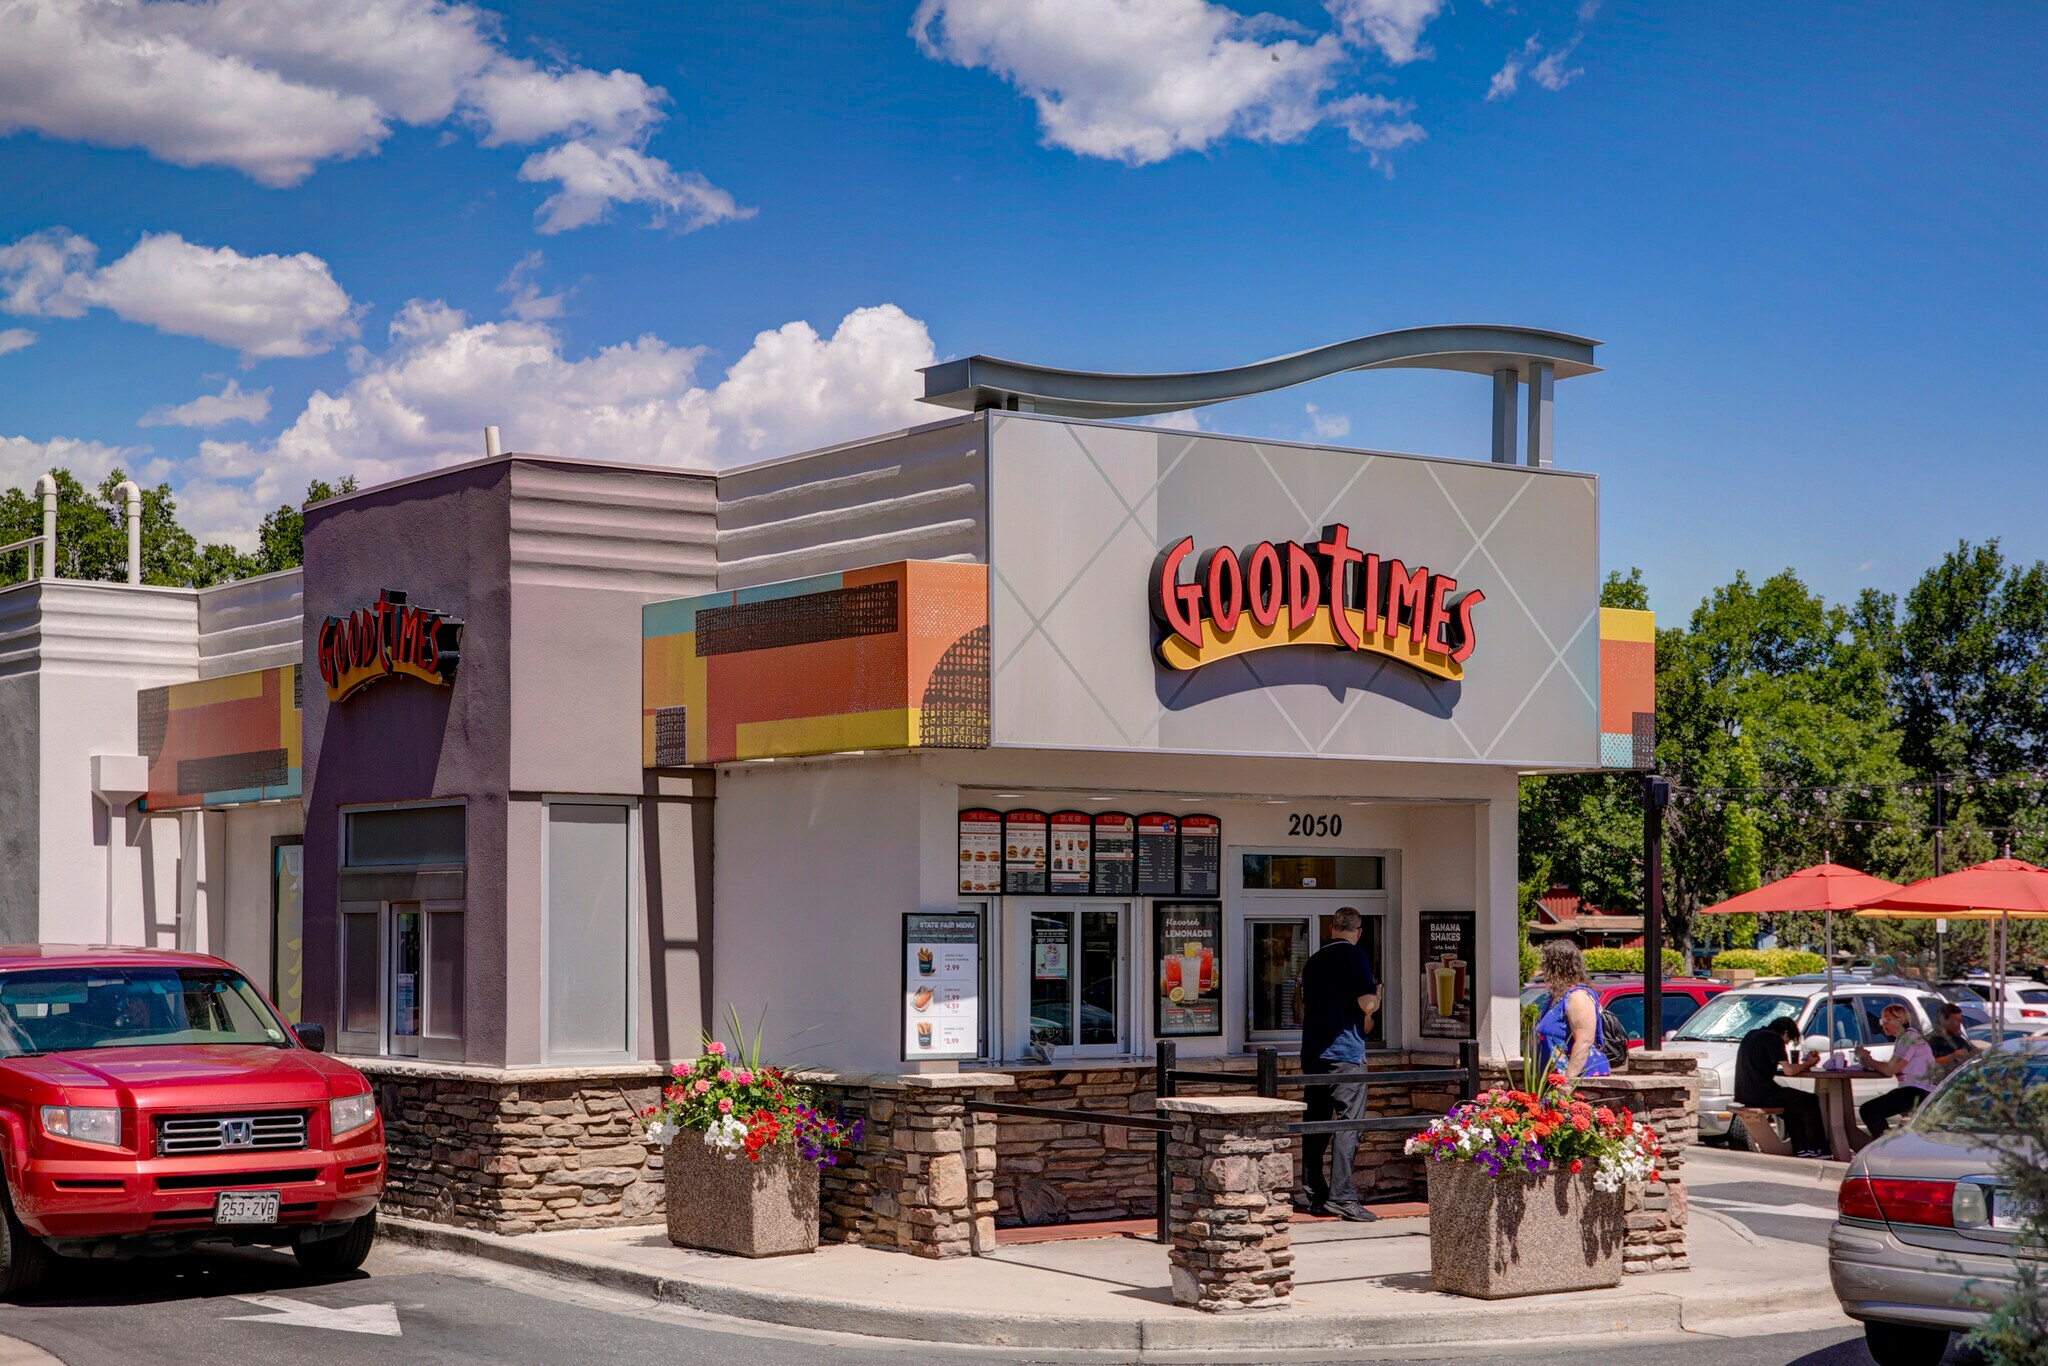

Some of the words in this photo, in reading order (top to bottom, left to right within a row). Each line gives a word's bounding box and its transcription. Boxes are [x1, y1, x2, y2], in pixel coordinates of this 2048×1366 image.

[1288, 813, 1342, 837] 2050
[919, 921, 939, 929] STATE
[940, 921, 955, 929] FAIR
[1430, 923, 1461, 932] BANANA
[1165, 929, 1213, 938] LEMONADES
[1430, 932, 1461, 942] SHAKES
